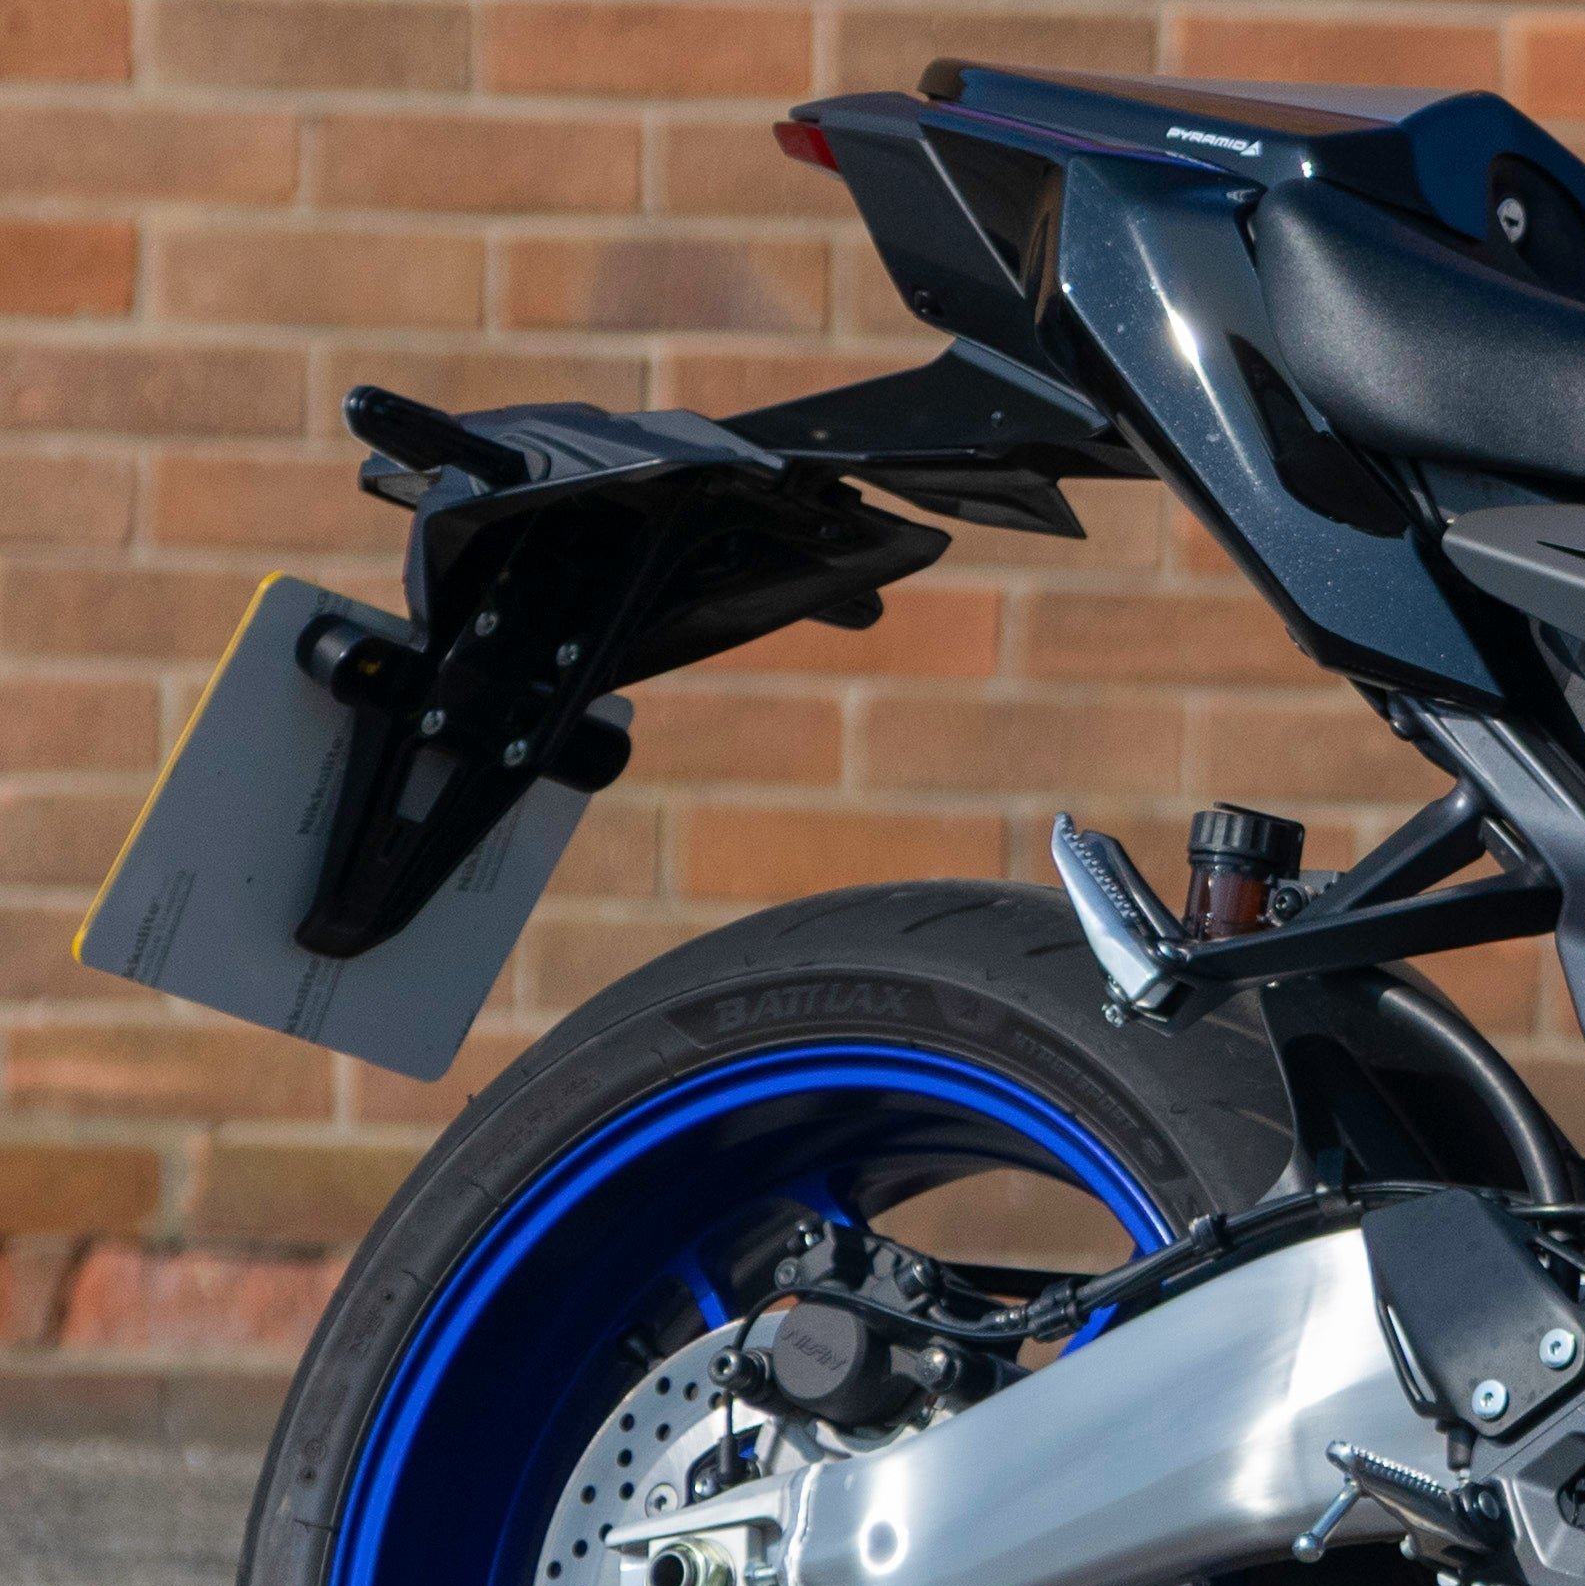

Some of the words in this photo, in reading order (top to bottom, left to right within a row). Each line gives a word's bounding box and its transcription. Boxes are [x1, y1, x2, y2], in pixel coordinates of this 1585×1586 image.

[1167, 126, 1250, 151] PYRAMID
[713, 984, 912, 1028] BATTLAX
[781, 1328, 847, 1370] NISSIN
